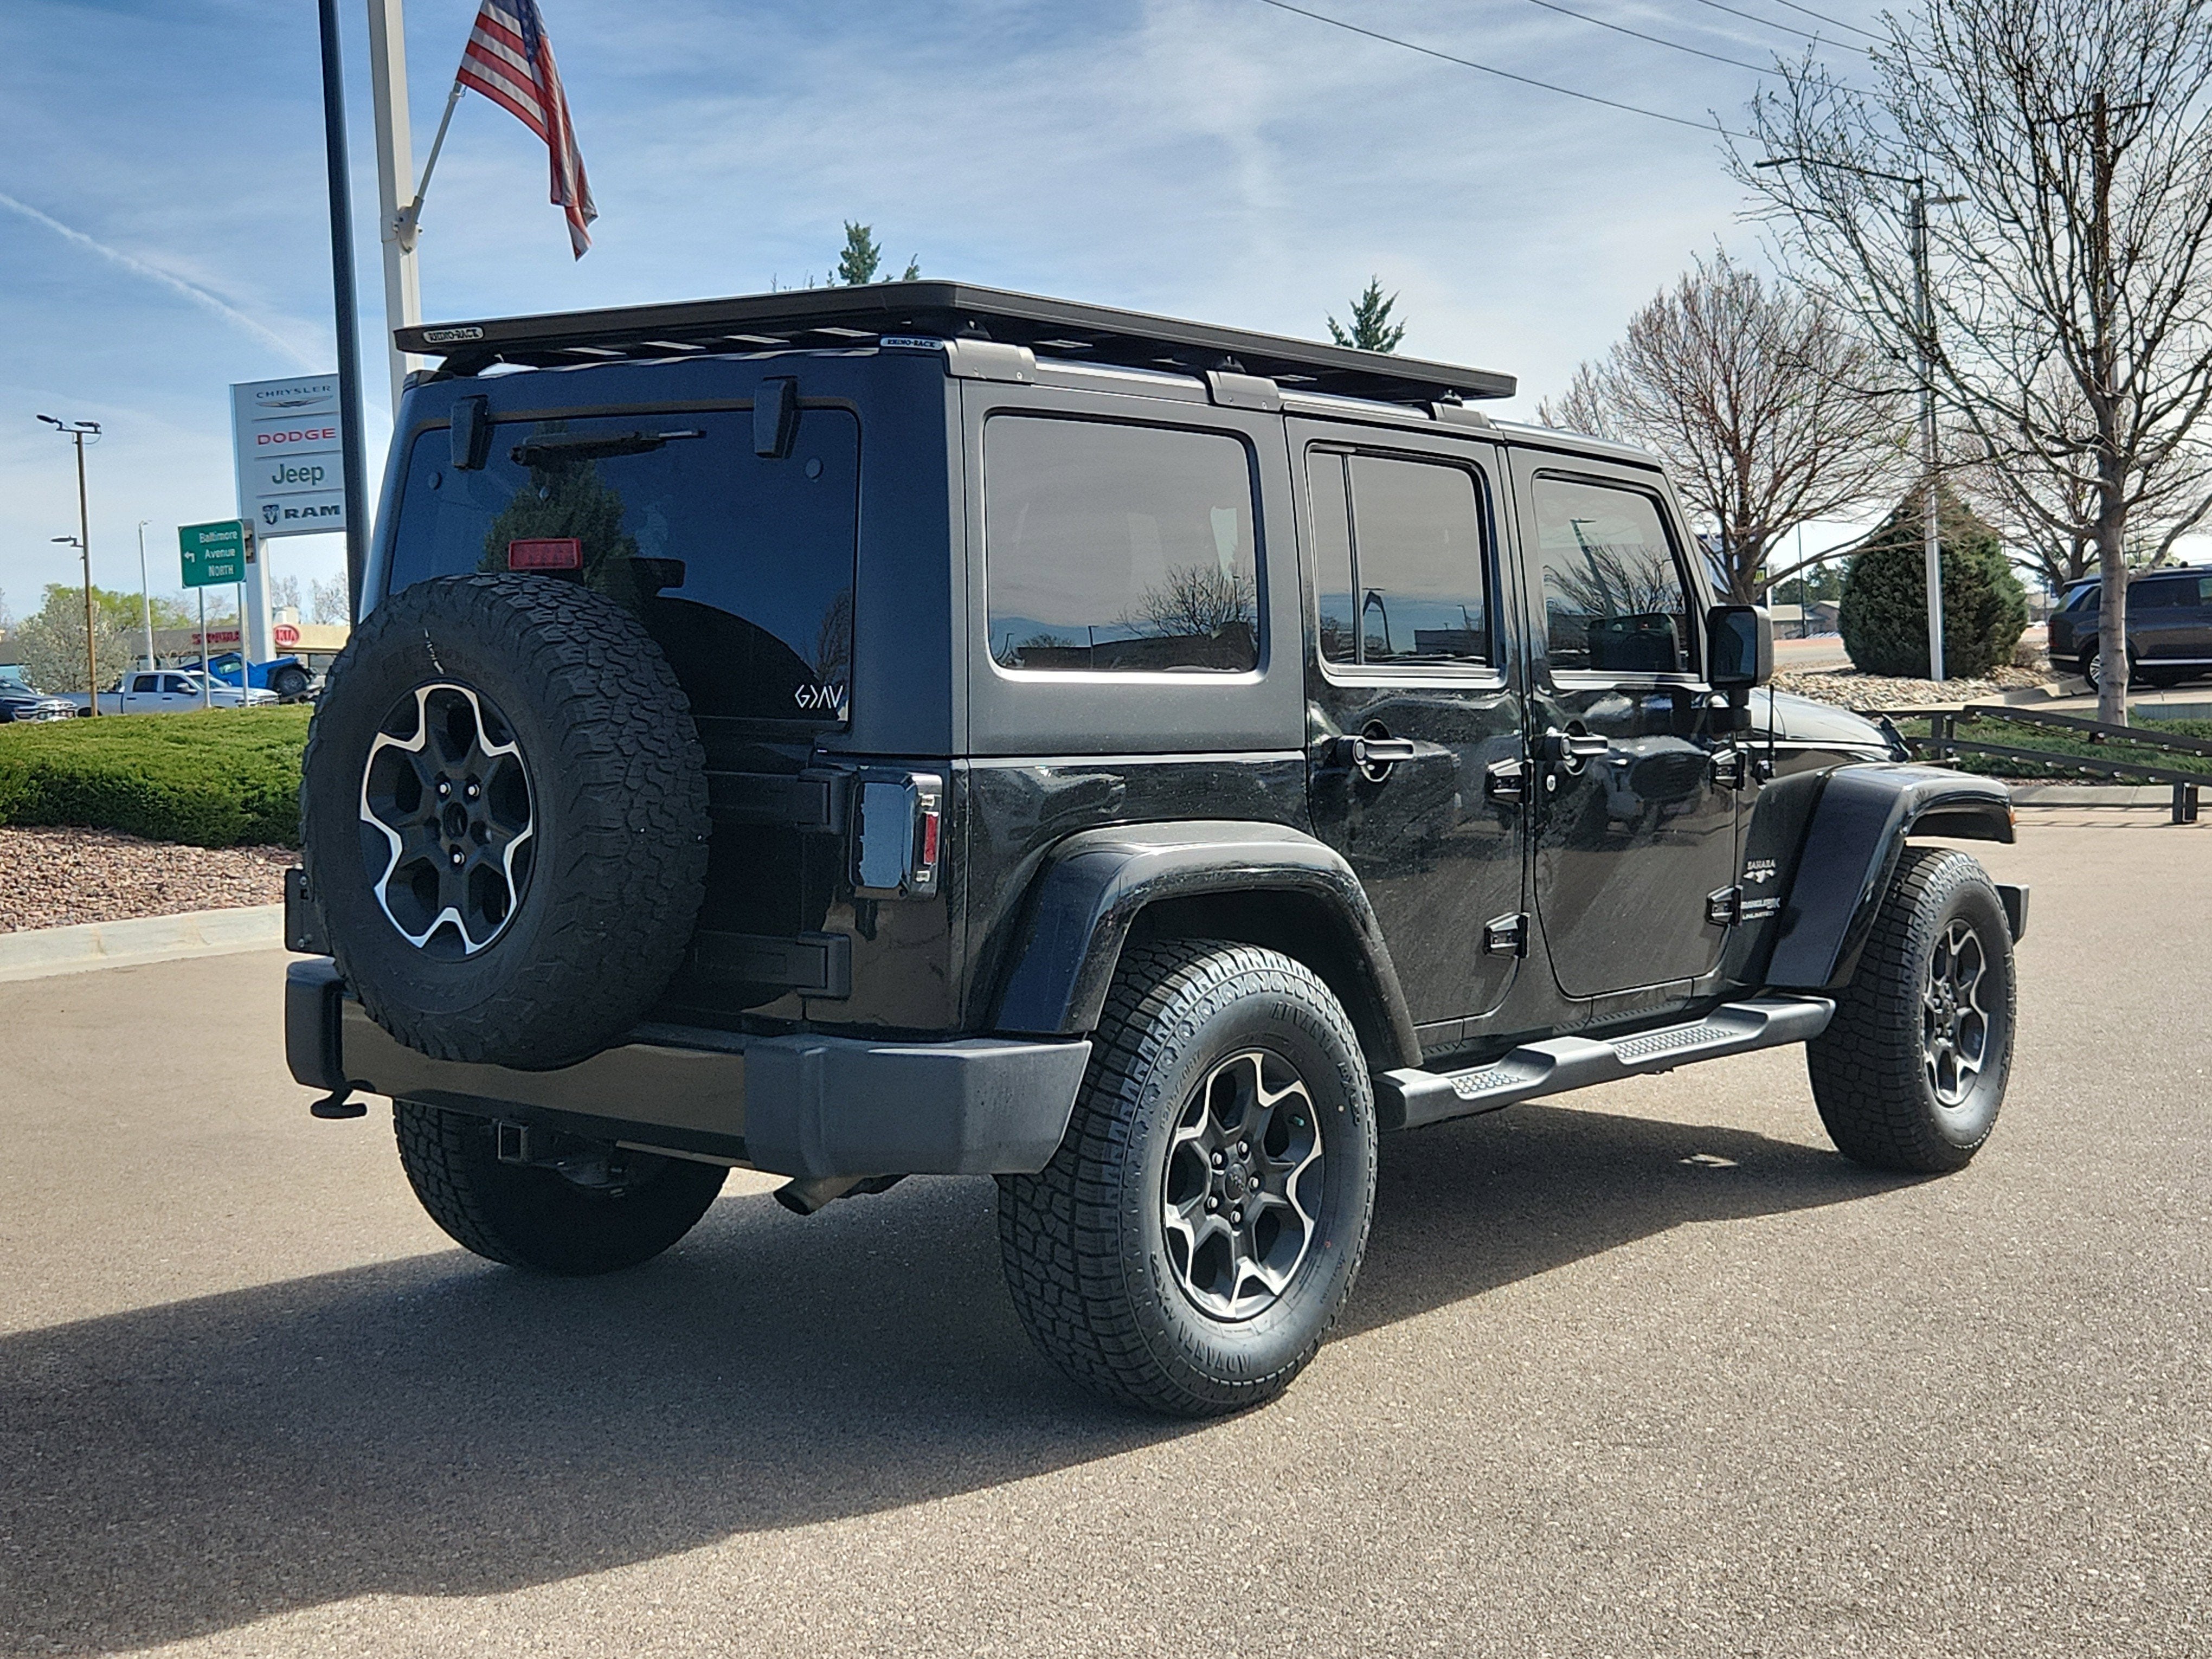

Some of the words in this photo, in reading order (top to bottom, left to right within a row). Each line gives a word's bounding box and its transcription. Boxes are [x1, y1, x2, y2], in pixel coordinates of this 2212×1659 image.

[428, 329, 480, 341] RHINO-RACK
[887, 339, 936, 348] RHINO-RACK
[256, 385, 332, 398] CHRYSLER
[258, 428, 337, 445] DODGE
[272, 464, 324, 485] Jeep
[285, 505, 340, 519] RAM
[199, 531, 237, 543] Baltimore
[204, 548, 235, 559] Avenue
[208, 564, 234, 577] NORTH
